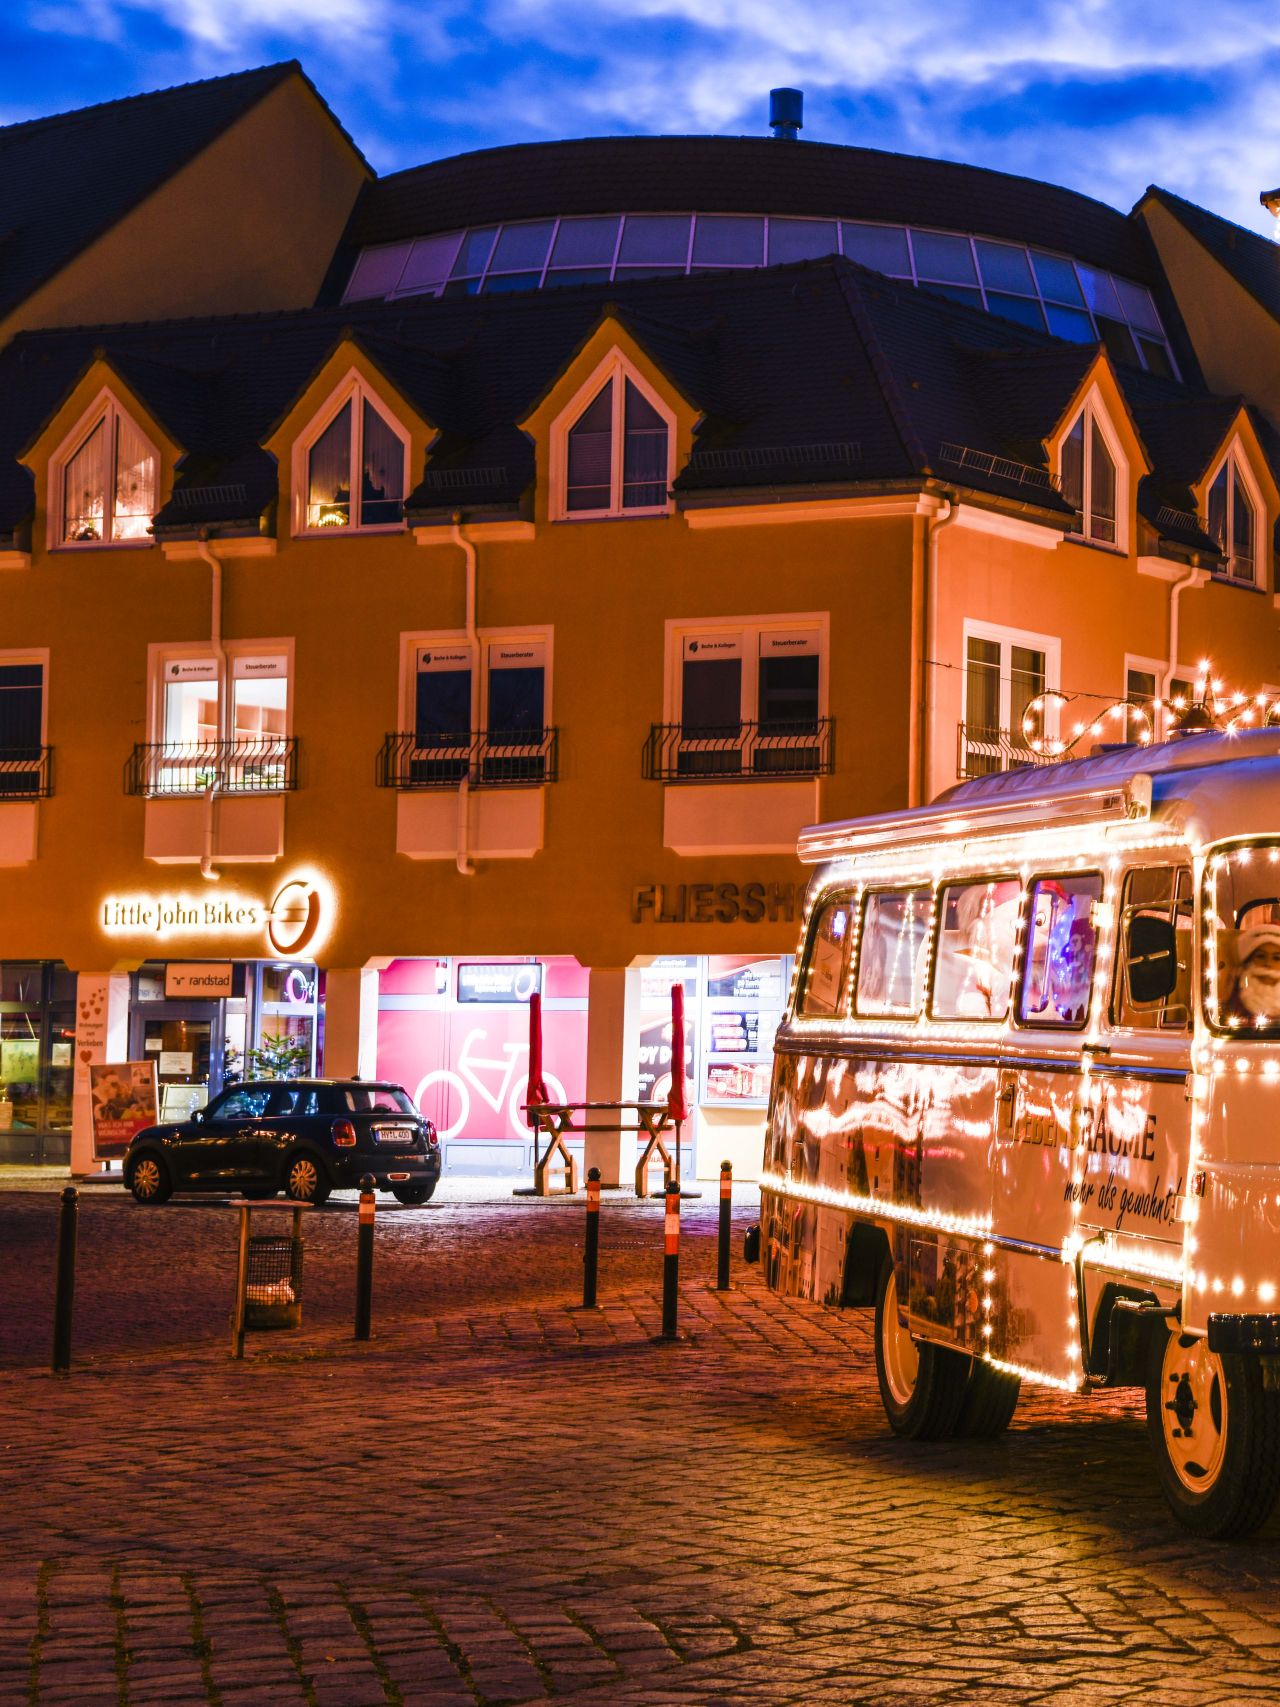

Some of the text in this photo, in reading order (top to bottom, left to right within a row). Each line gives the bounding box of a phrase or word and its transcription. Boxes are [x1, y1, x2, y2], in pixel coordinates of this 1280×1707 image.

[772, 639, 808, 647] Steuerberater
[245, 663, 277, 671] Steuerberater
[104, 901, 257, 931] Little John Bikes
[188, 974, 230, 986] randstad
[1063, 1164, 1095, 1203] mehr
[1098, 1168, 1117, 1211] als
